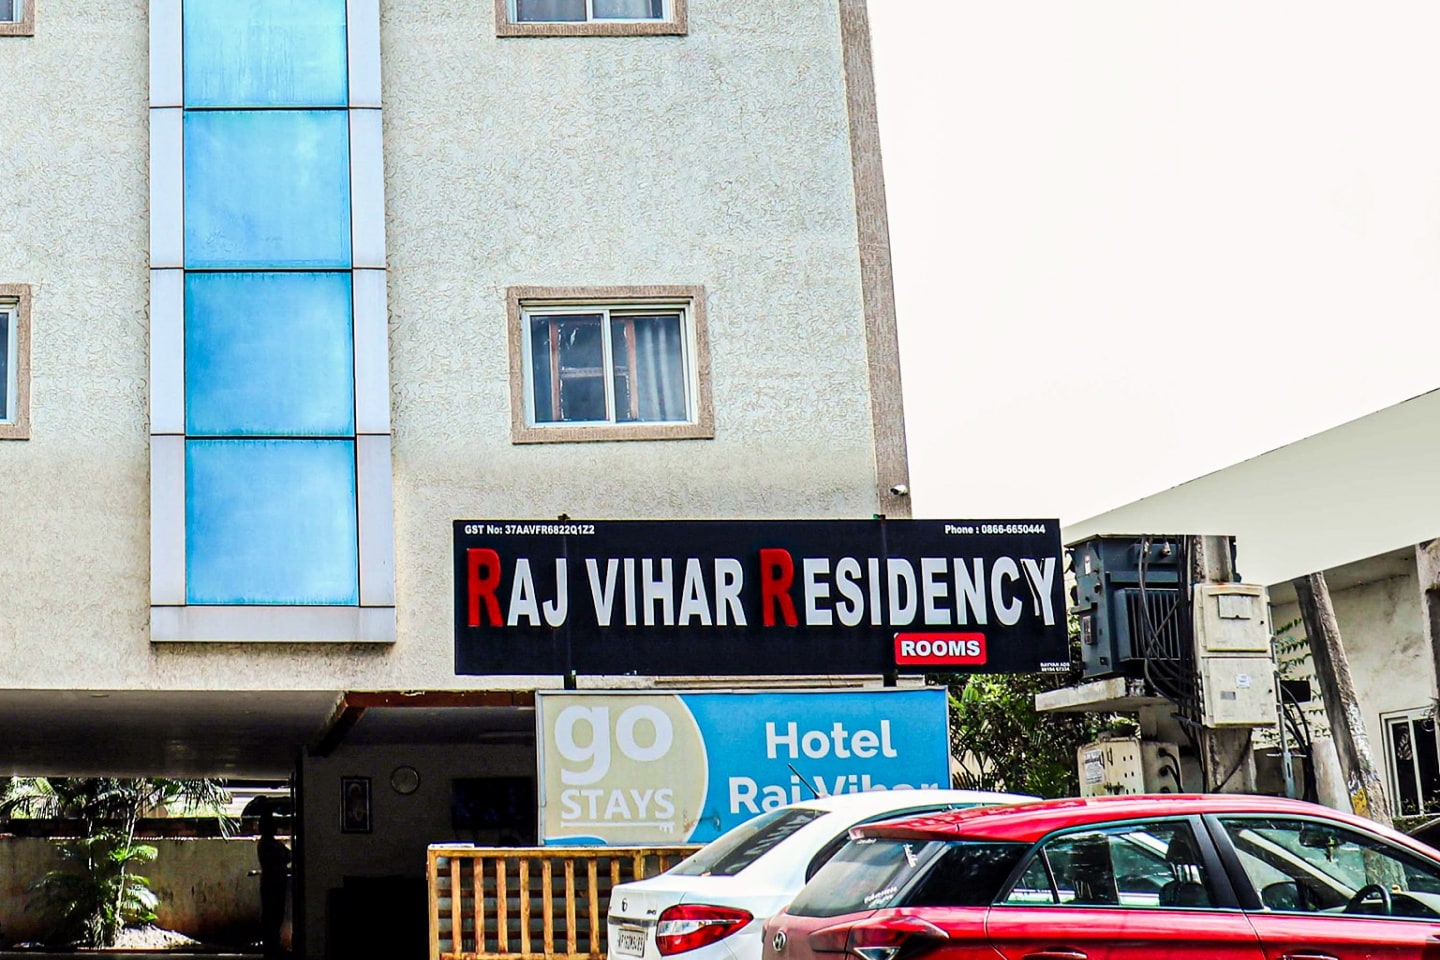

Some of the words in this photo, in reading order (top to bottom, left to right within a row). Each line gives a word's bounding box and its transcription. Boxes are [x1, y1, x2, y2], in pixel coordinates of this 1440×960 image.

[464, 525, 484, 535] GST
[486, 525, 503, 535] No:
[944, 524, 974, 534] Phone
[981, 524, 1046, 534] 0866-6650444
[466, 547, 568, 627] RAJ
[585, 557, 748, 627] VIHAR
[759, 547, 1057, 627] RESIDENCY
[900, 640, 981, 657] ROOMS
[554, 703, 673, 785] go
[766, 719, 897, 759] Hotel
[561, 788, 675, 821] STAYS
